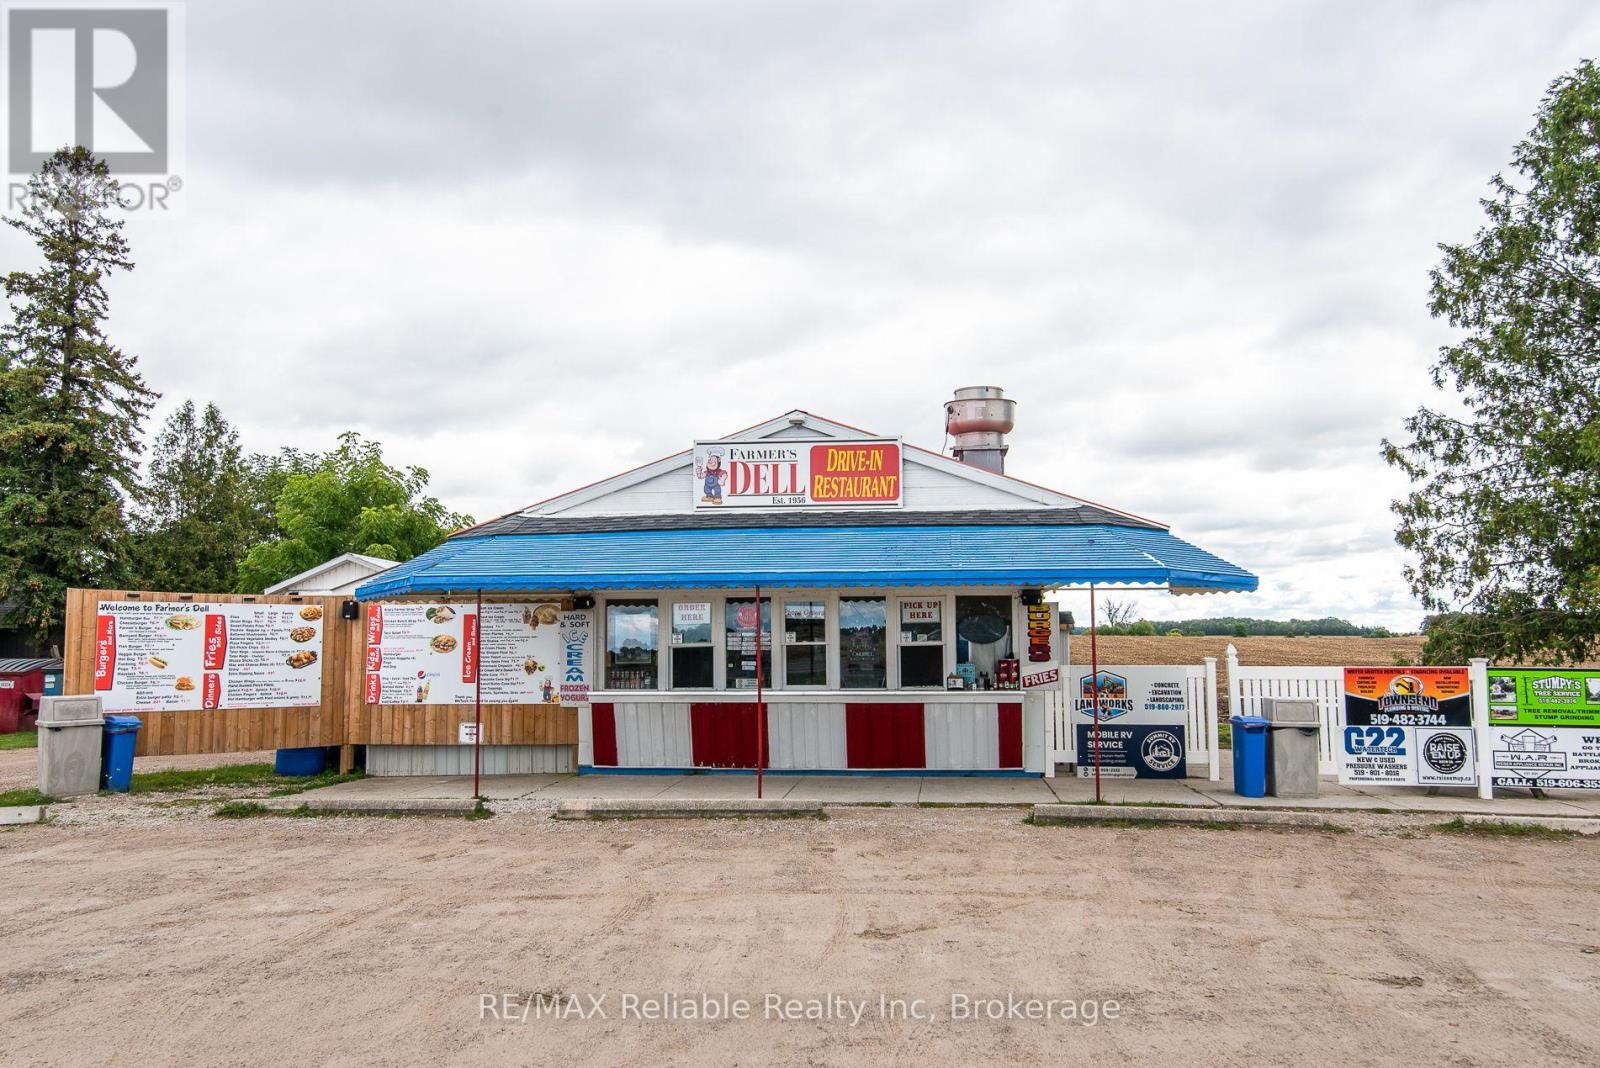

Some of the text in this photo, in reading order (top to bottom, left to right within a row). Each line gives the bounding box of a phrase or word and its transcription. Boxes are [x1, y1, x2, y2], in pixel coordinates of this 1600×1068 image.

[730, 448, 797, 460] FARMER'S
[827, 448, 884, 472] DRIVE-IN
[729, 461, 805, 495] DELL
[813, 474, 897, 498] RESTAURANT
[773, 497, 786, 505] Est.
[99, 604, 141, 612] Welcome
[155, 603, 190, 612] Farmer's
[193, 604, 209, 612] Dell
[904, 601, 923, 609] PICK
[367, 616, 376, 643] Wraps
[562, 629, 588, 644] ICE
[96, 640, 109, 677] Burgers
[205, 637, 216, 667] Fries
[367, 652, 375, 670] Kids
[566, 644, 584, 682] CREAM
[1023, 670, 1058, 686] FRIES
[1533, 677, 1581, 689] STUMPY'S
[205, 674, 215, 708] Dinners
[368, 675, 376, 703] Drinks
[1075, 699, 1133, 711] LANWORKS
[1378, 695, 1439, 710] TOWNSEND
[1344, 727, 1406, 755] G22
[1430, 743, 1460, 752] RAISE
[1447, 751, 1461, 759] UP
[1149, 759, 1175, 769] SERVICE
